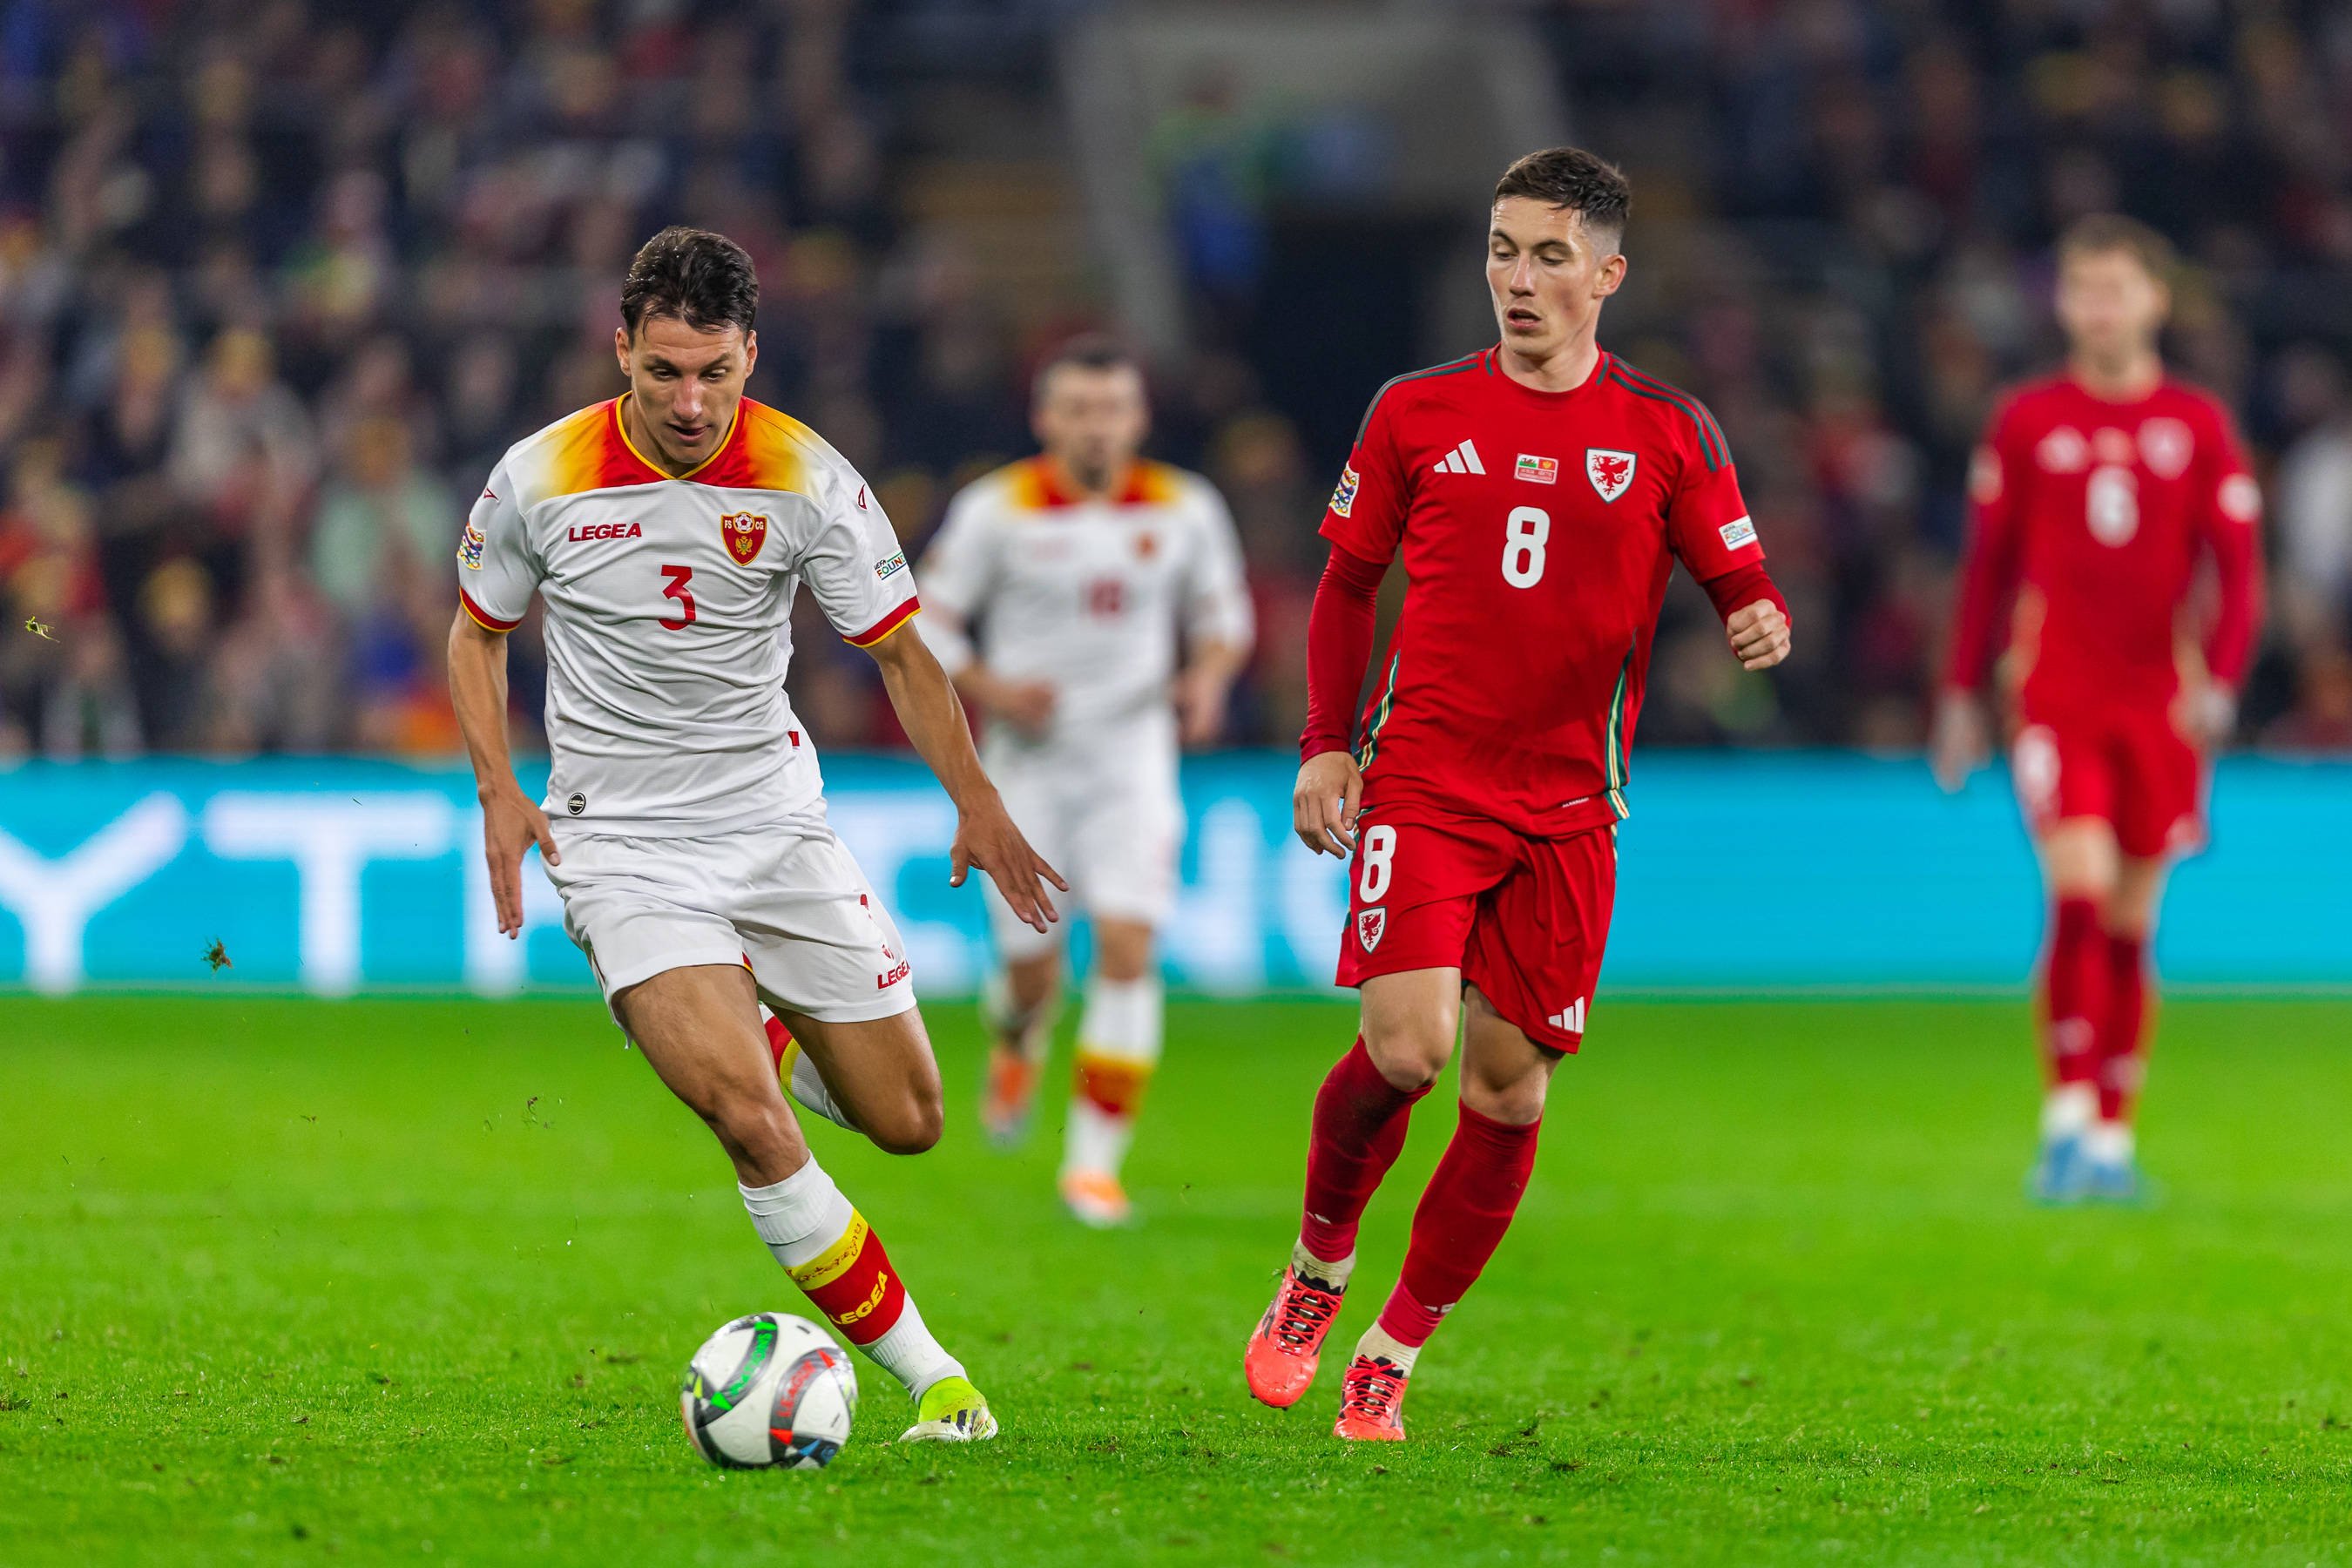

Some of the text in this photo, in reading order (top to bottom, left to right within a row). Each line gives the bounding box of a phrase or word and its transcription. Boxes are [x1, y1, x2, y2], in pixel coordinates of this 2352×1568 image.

[568, 523, 642, 542] LEGEA
[1502, 506, 1550, 589] 8
[874, 559, 887, 571] UEFA
[658, 564, 696, 631] 3
[1359, 824, 1397, 903] 8
[828, 1270, 888, 1324] LEGEA
